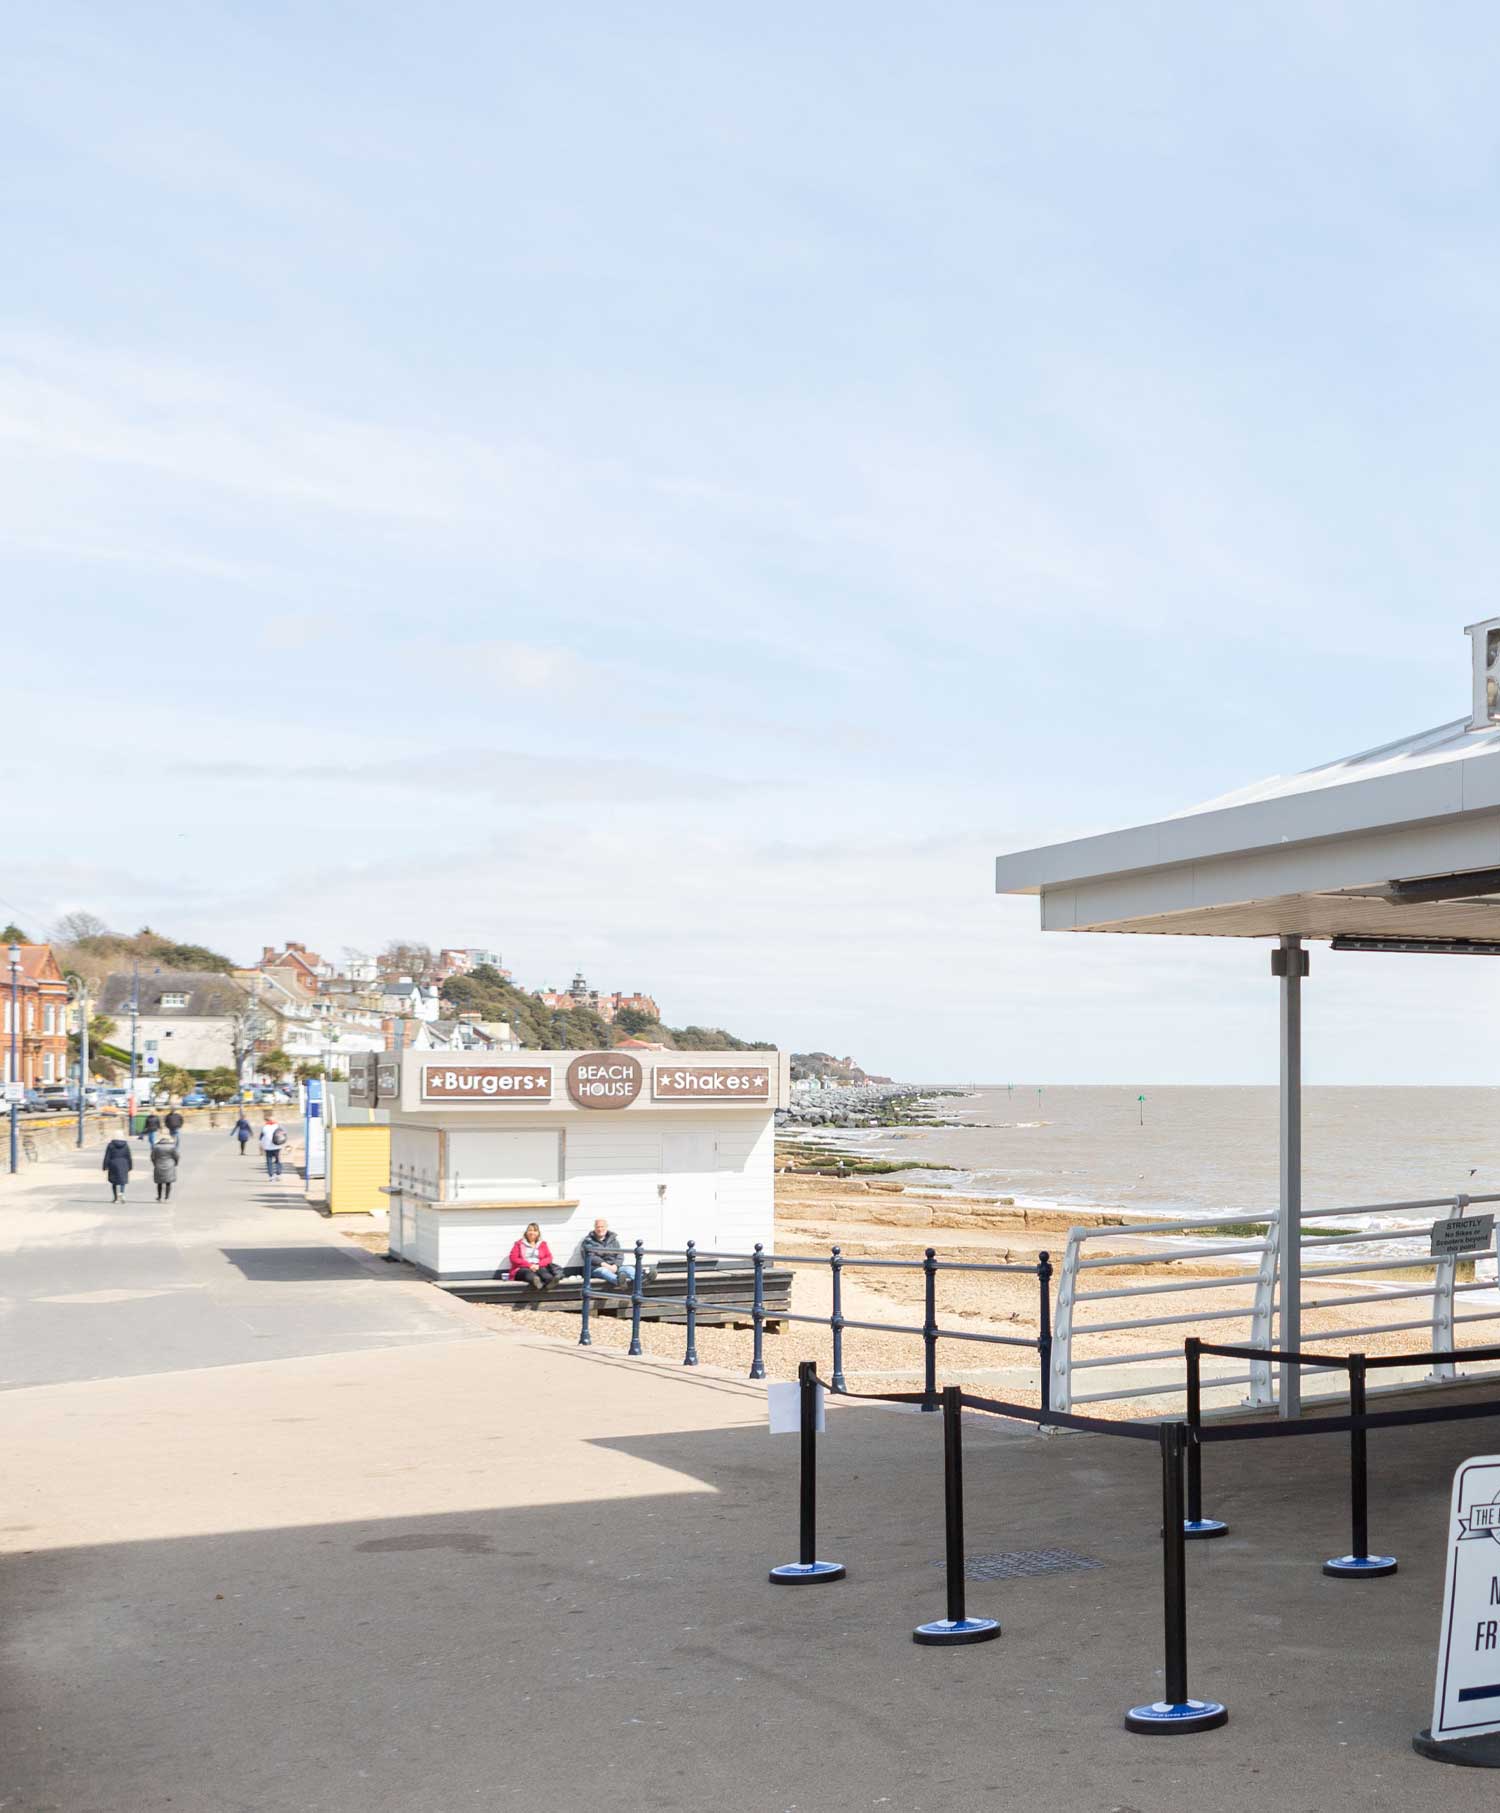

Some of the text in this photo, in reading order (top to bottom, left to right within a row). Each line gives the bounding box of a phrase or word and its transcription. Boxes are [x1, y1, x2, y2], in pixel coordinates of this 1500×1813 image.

[577, 1066, 634, 1080] BEACH
[673, 1072, 750, 1090] Shakes
[444, 1072, 534, 1094] Burgers
[578, 1082, 633, 1096] HOUSE
[1476, 1508, 1495, 1526] THE
